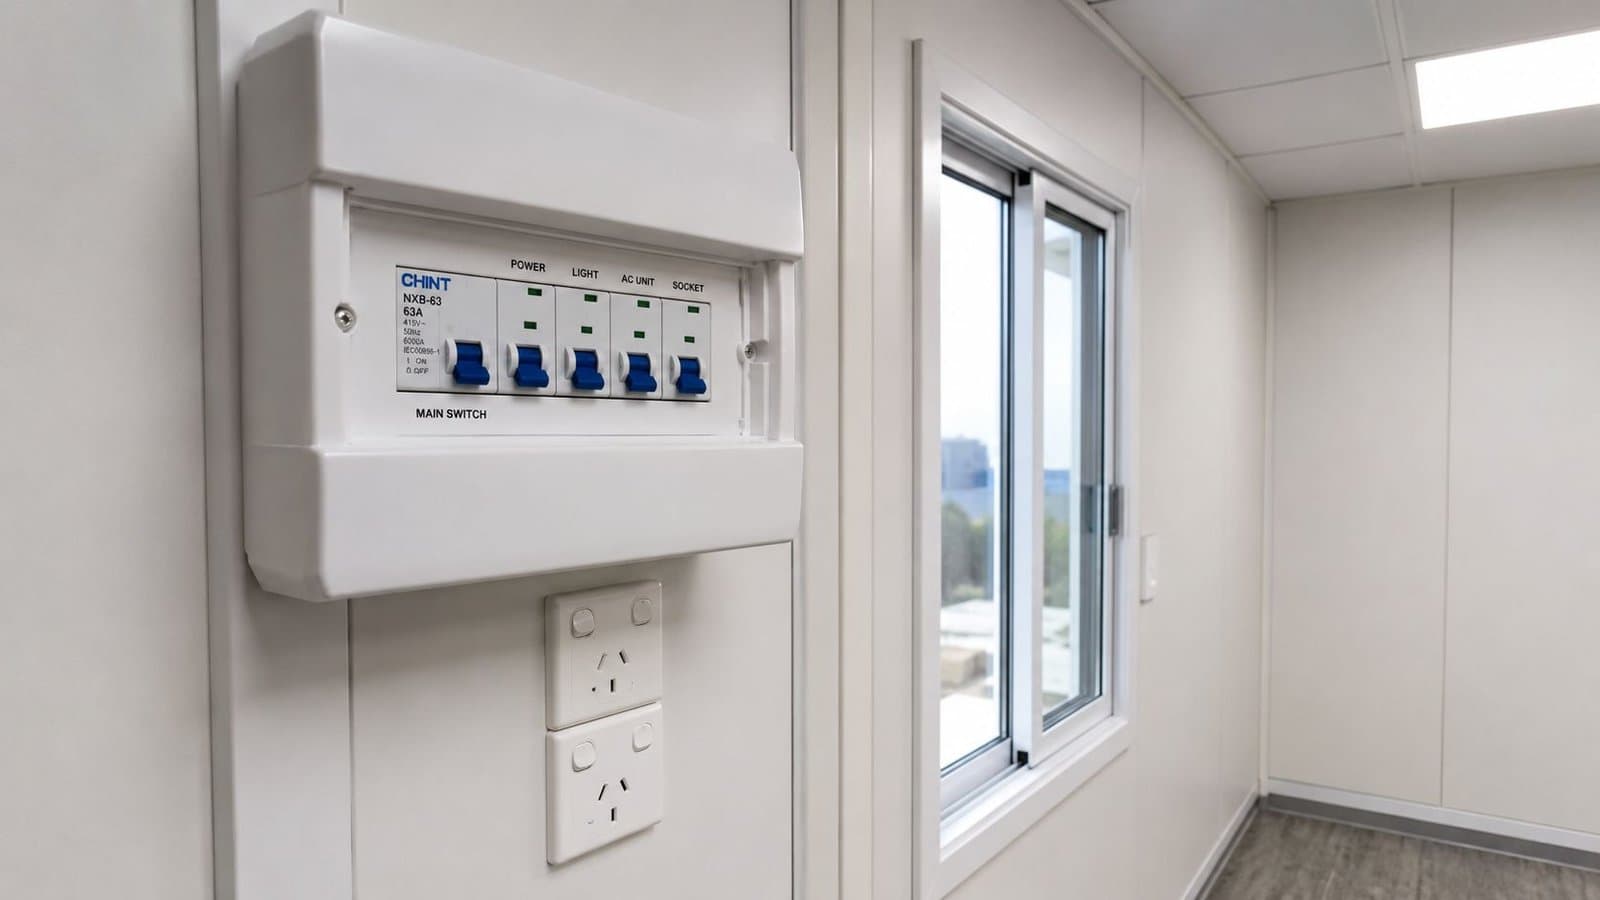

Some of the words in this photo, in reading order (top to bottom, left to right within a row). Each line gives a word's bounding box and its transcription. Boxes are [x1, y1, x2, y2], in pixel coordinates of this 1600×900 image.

[510, 259, 546, 273] POWER
[571, 267, 599, 279] LIGHT
[401, 273, 451, 291] CHINT
[621, 274, 634, 284] AC
[636, 276, 655, 286] UNIT
[672, 280, 705, 293] SOCKET
[403, 293, 442, 306] NXB-63
[403, 306, 423, 317] 63A
[416, 408, 444, 418] MAIN
[446, 408, 487, 419] SWITCH
